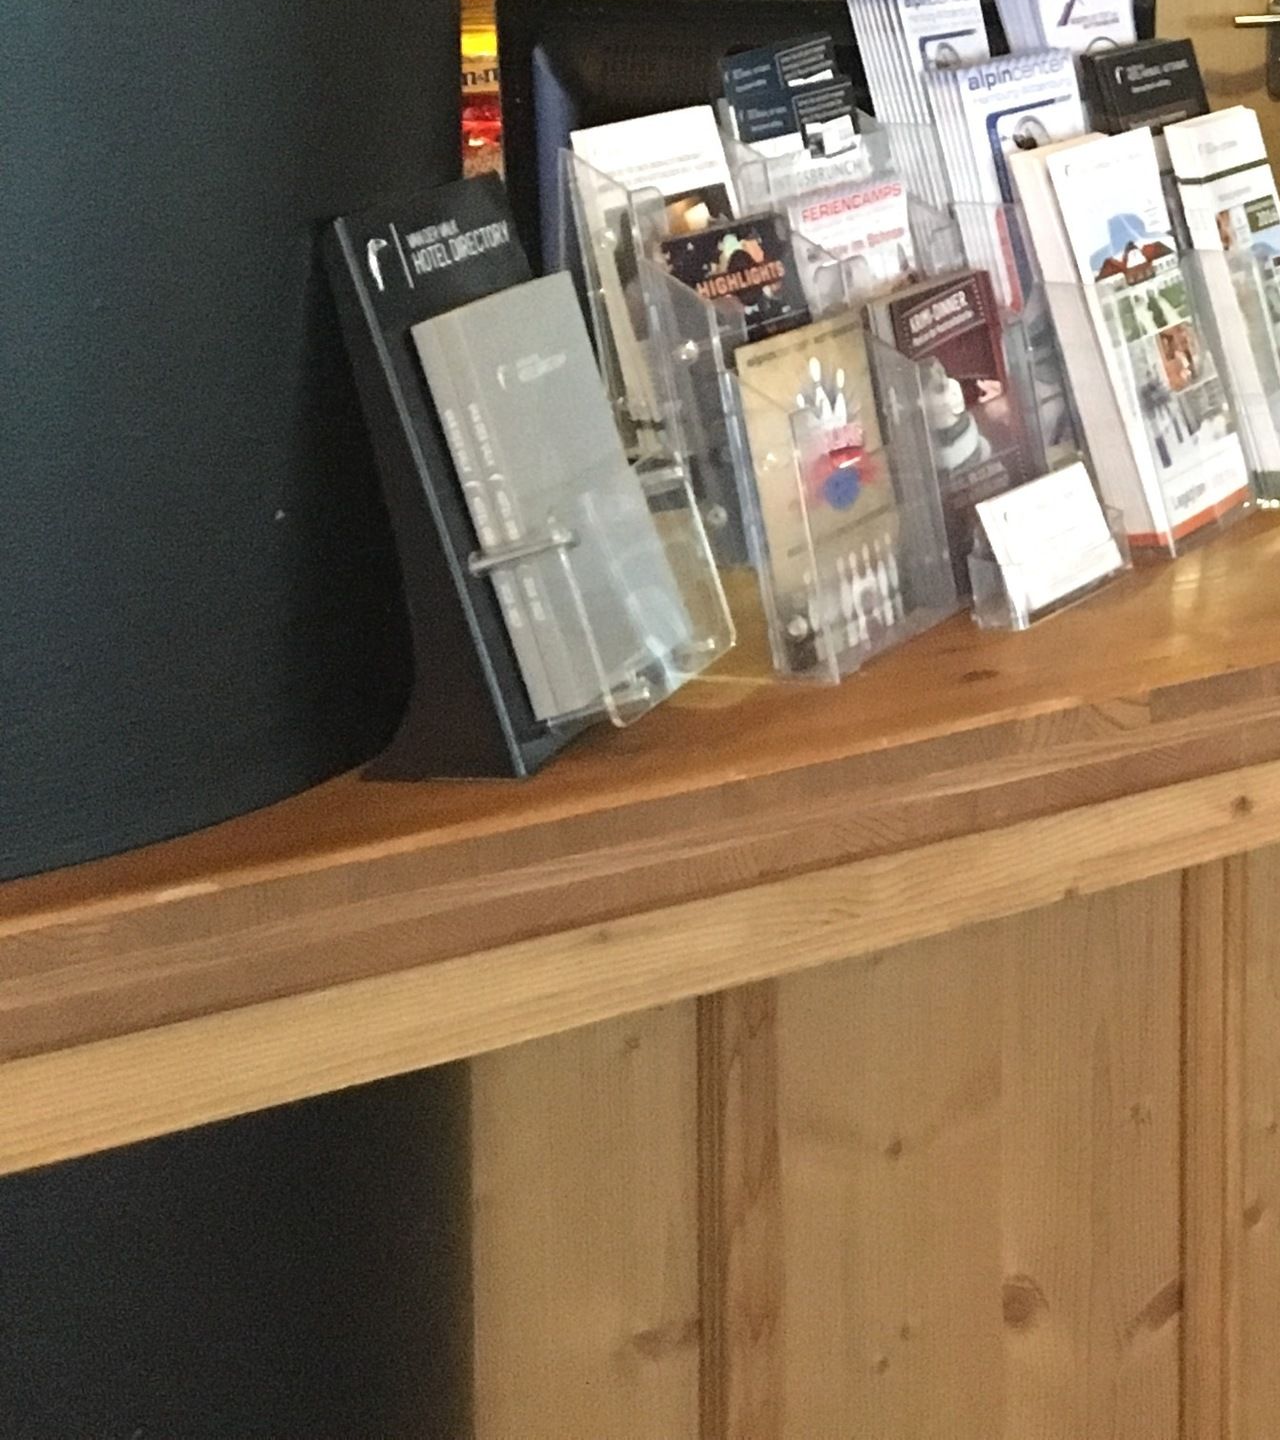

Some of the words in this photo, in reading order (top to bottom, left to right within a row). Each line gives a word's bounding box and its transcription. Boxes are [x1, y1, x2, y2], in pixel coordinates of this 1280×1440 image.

[968, 53, 1071, 91] alpincenter
[802, 183, 902, 224] FERIENCAMPS
[411, 243, 452, 275] HOTEL
[448, 220, 510, 262] DIRECTORY
[696, 260, 786, 299] HIGHLIGHTS
